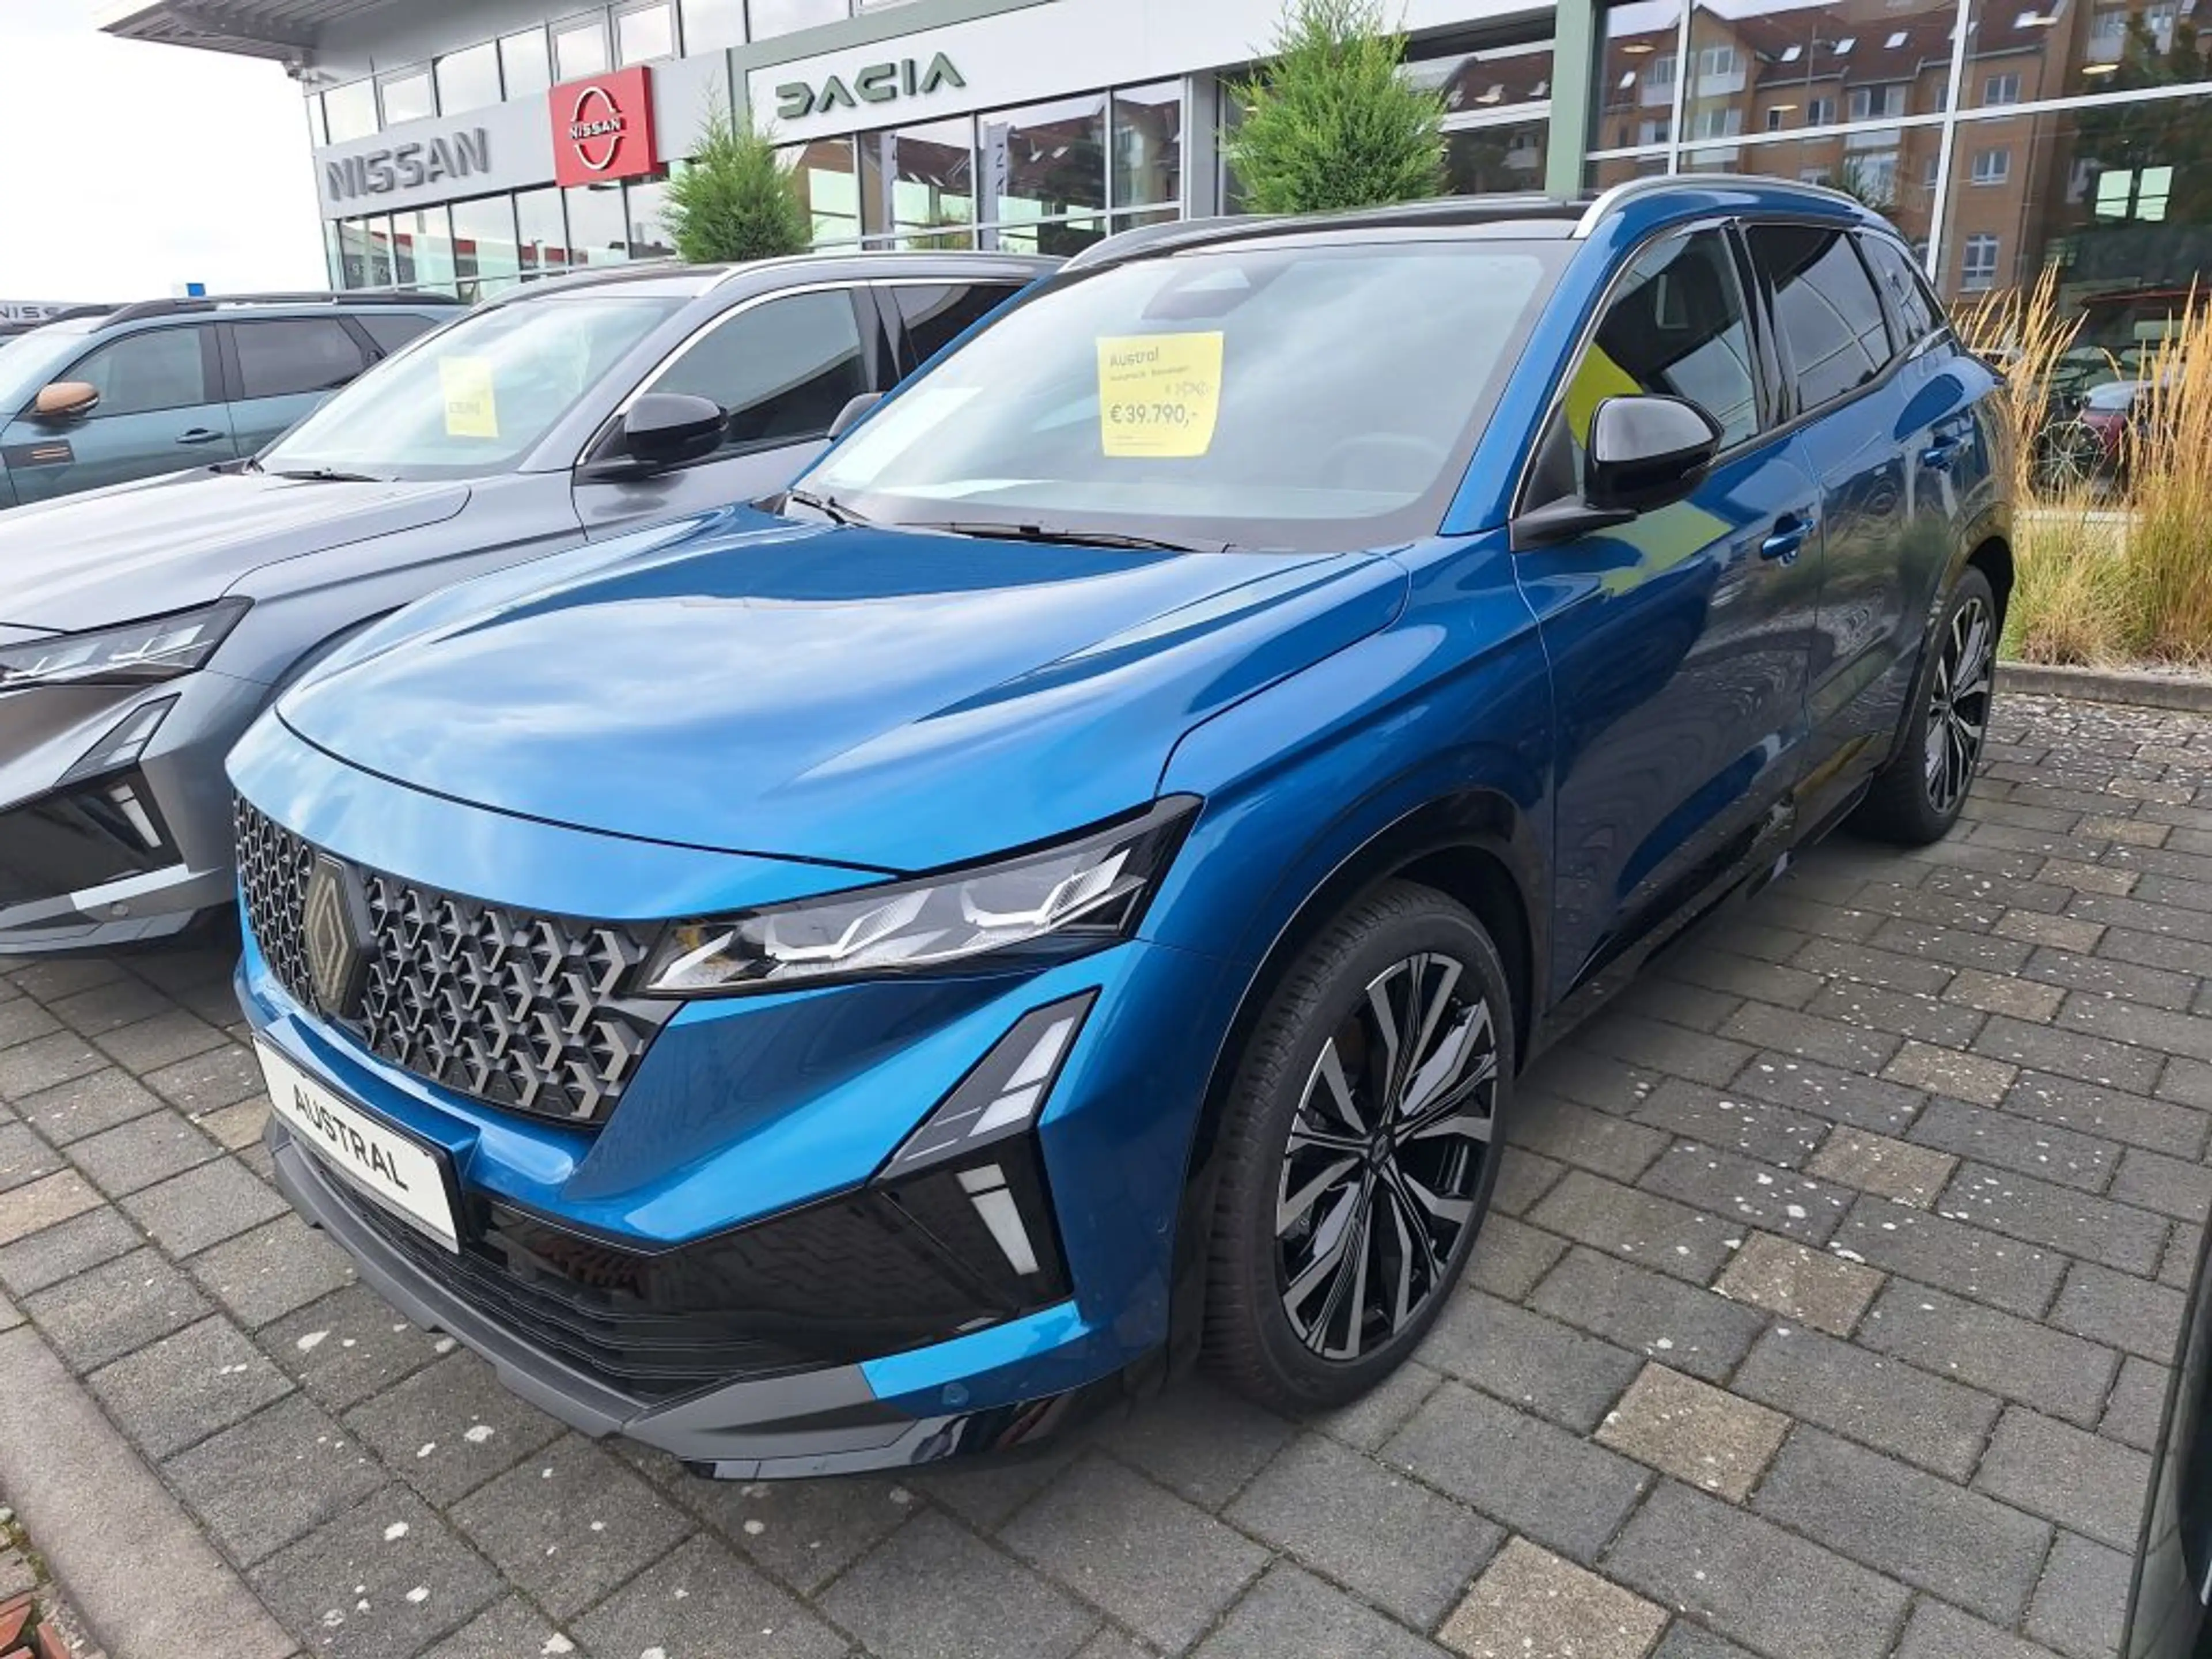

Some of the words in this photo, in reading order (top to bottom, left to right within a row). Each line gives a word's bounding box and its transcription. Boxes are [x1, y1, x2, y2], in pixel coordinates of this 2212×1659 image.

[775, 52, 967, 119] DACIA
[570, 117, 621, 139] NISSAN
[326, 128, 489, 202] NISSAN
[1109, 346, 1158, 366] Austral
[293, 1085, 409, 1192] AUSTRAL
